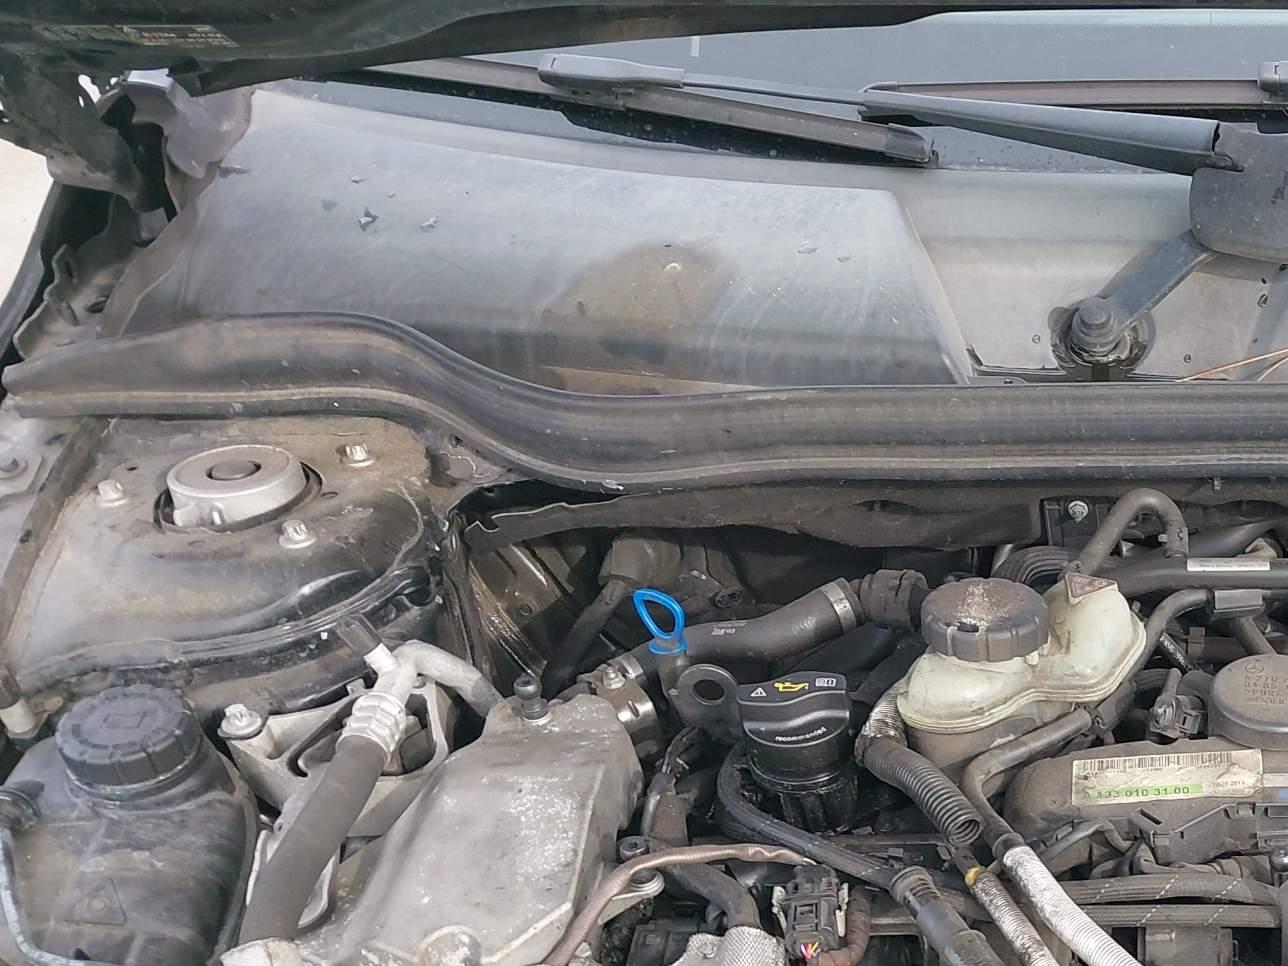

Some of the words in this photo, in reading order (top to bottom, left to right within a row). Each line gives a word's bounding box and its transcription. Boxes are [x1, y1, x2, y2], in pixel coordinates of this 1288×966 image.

[1125, 788, 1149, 798] 010
[1153, 787, 1169, 797] 31
[1173, 786, 1190, 795] 00
